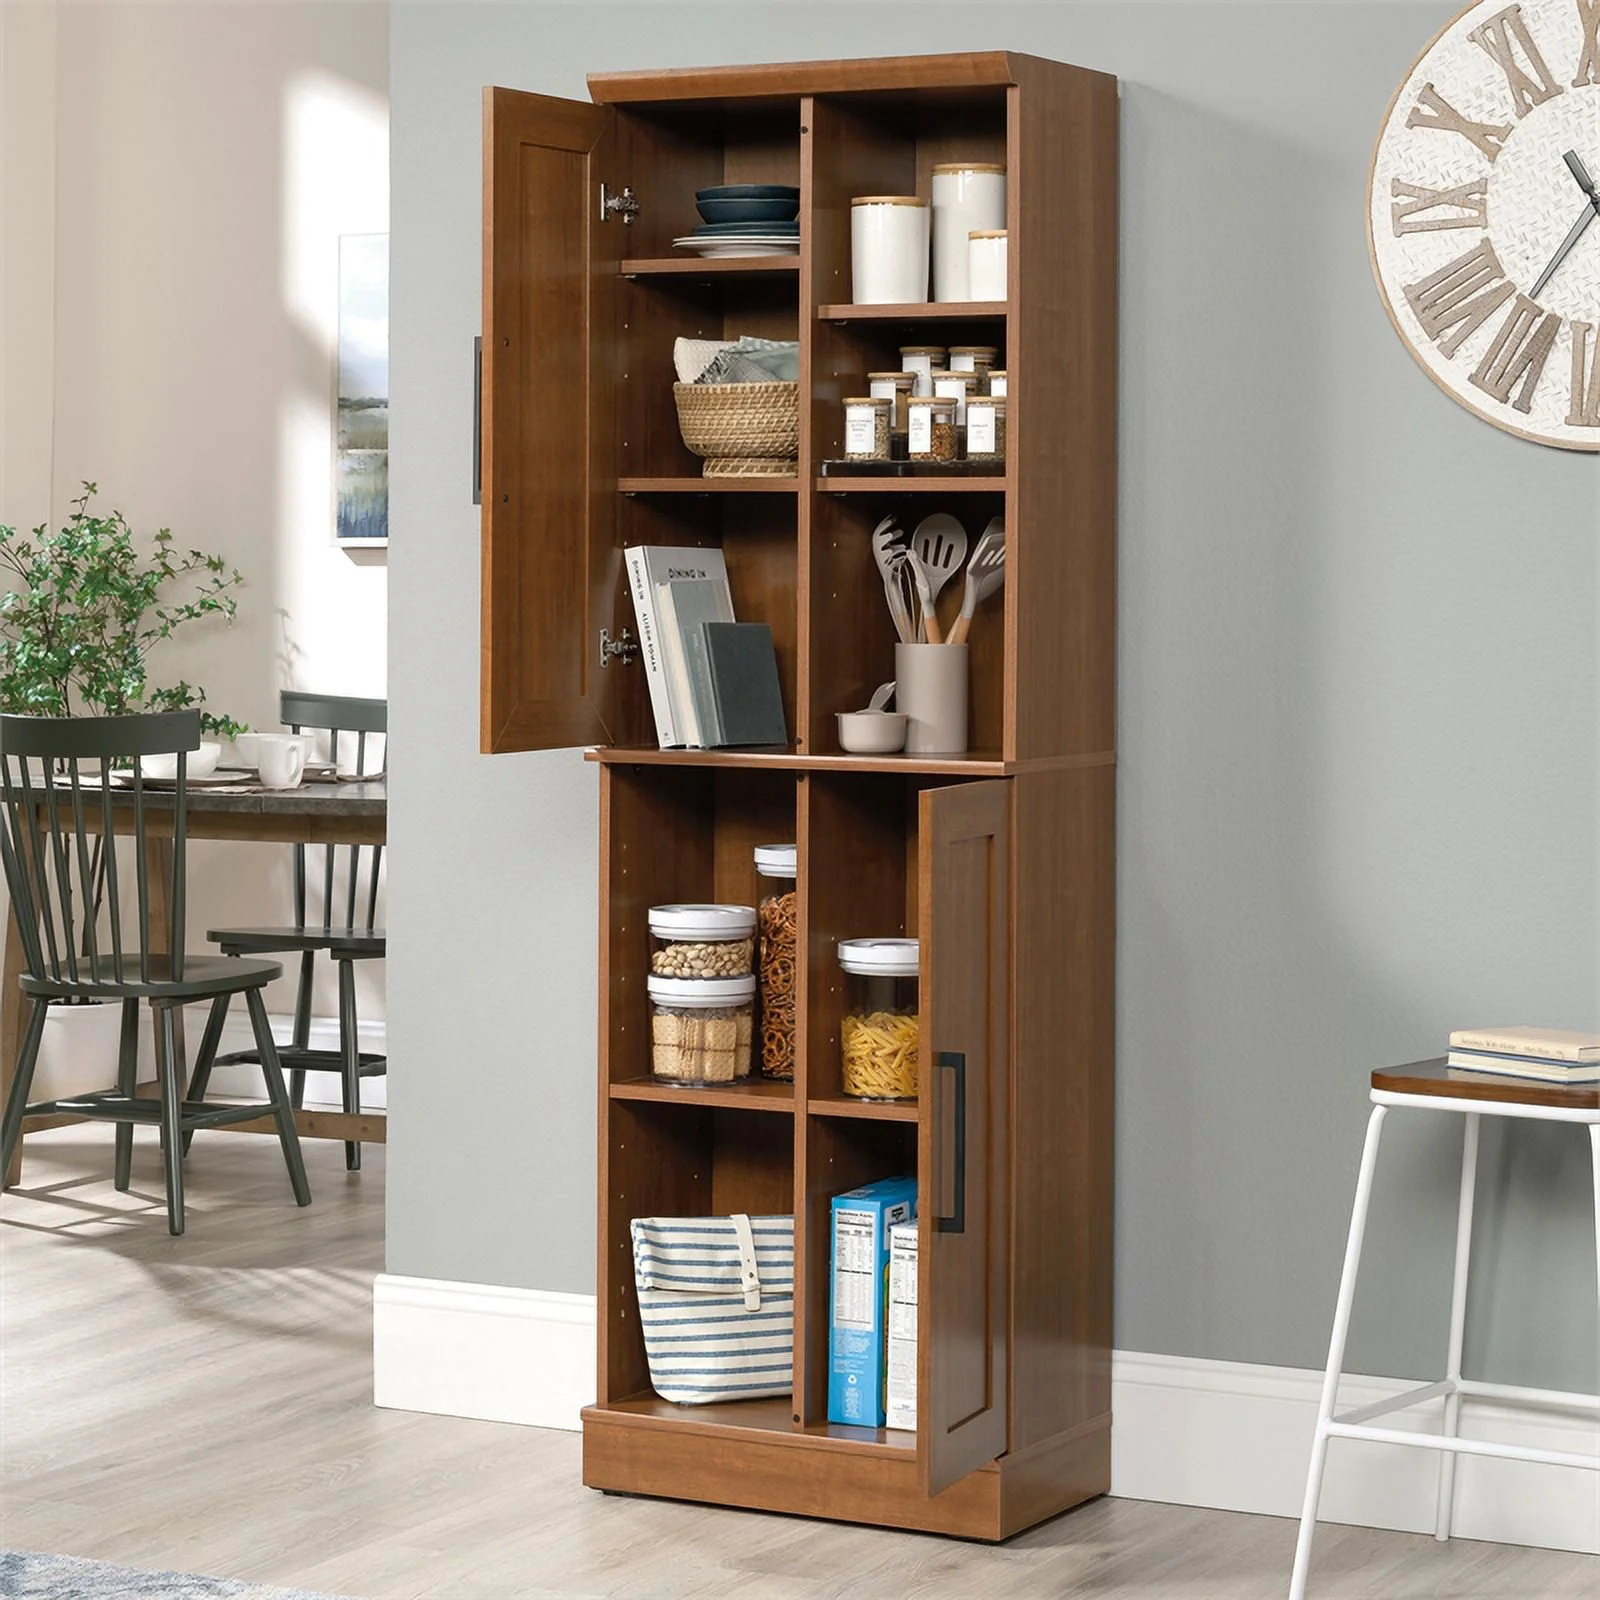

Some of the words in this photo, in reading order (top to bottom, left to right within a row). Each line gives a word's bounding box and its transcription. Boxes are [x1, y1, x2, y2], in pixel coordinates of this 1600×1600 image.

[1405, 82, 1515, 164] X
[1391, 177, 1489, 239] IX
[668, 567, 696, 579] DINING
